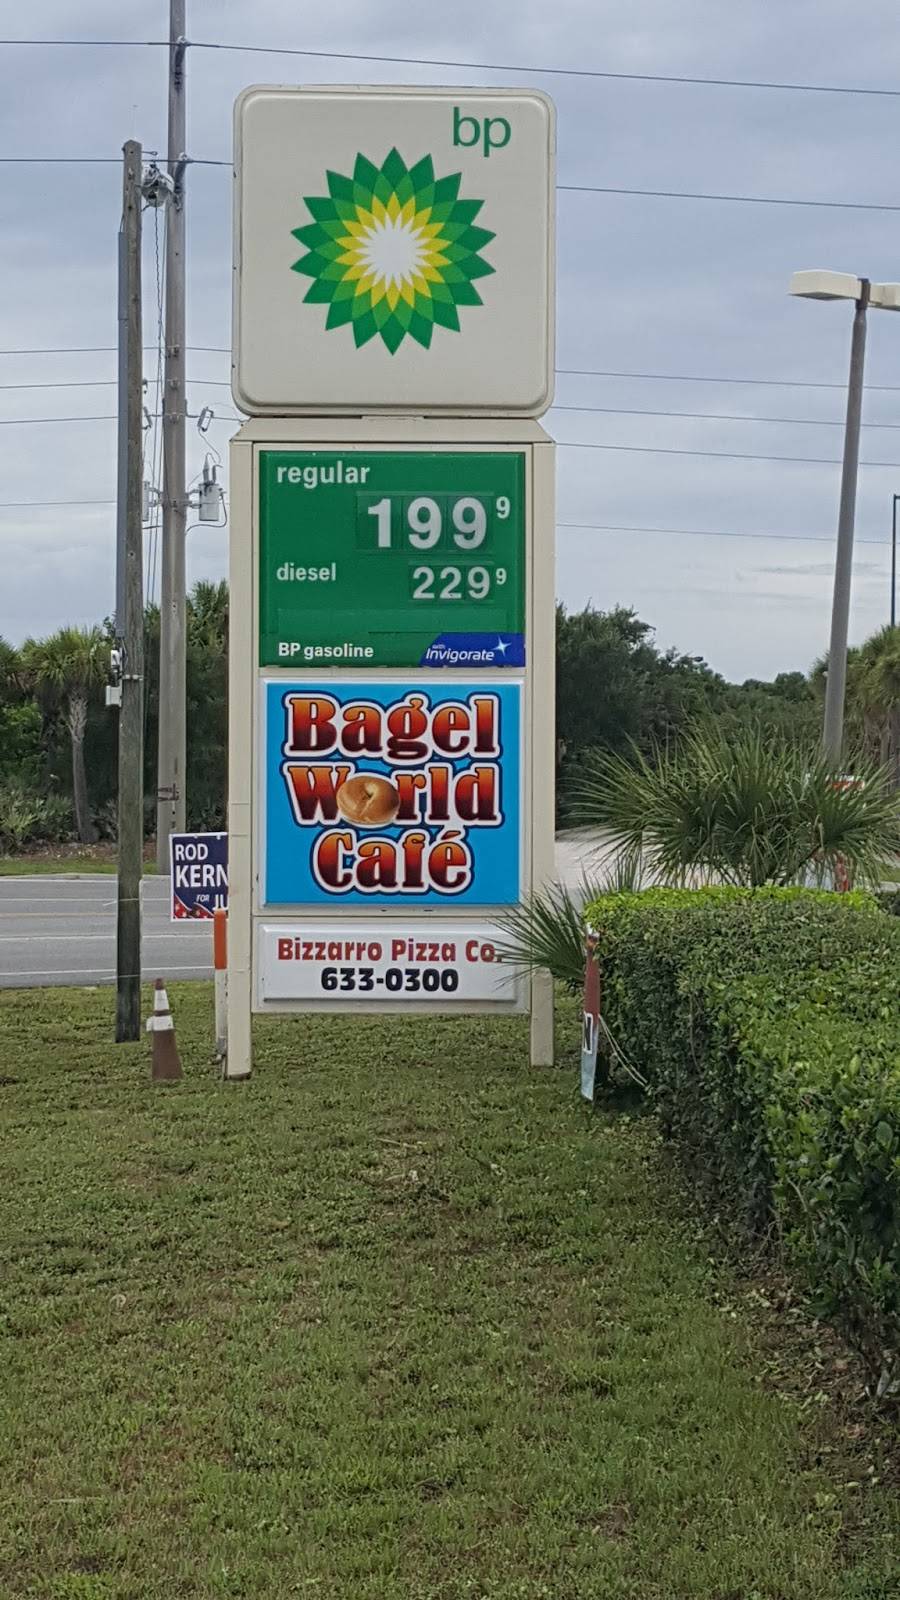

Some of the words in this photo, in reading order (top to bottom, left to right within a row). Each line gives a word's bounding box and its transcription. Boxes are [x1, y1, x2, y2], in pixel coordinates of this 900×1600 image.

[453, 106, 511, 158] bp
[276, 460, 371, 490] regular
[276, 562, 337, 582] diesel
[278, 641, 301, 657] BP
[304, 643, 374, 660] gasoline
[425, 647, 495, 663] Invigorate
[285, 694, 501, 763] Bagel
[175, 843, 208, 861] ROD
[314, 828, 470, 891] Café
[176, 864, 229, 888] KERN
[277, 937, 383, 961] Bizzarro
[391, 938, 457, 962] Pizza
[320, 967, 460, 992] 633-0300
